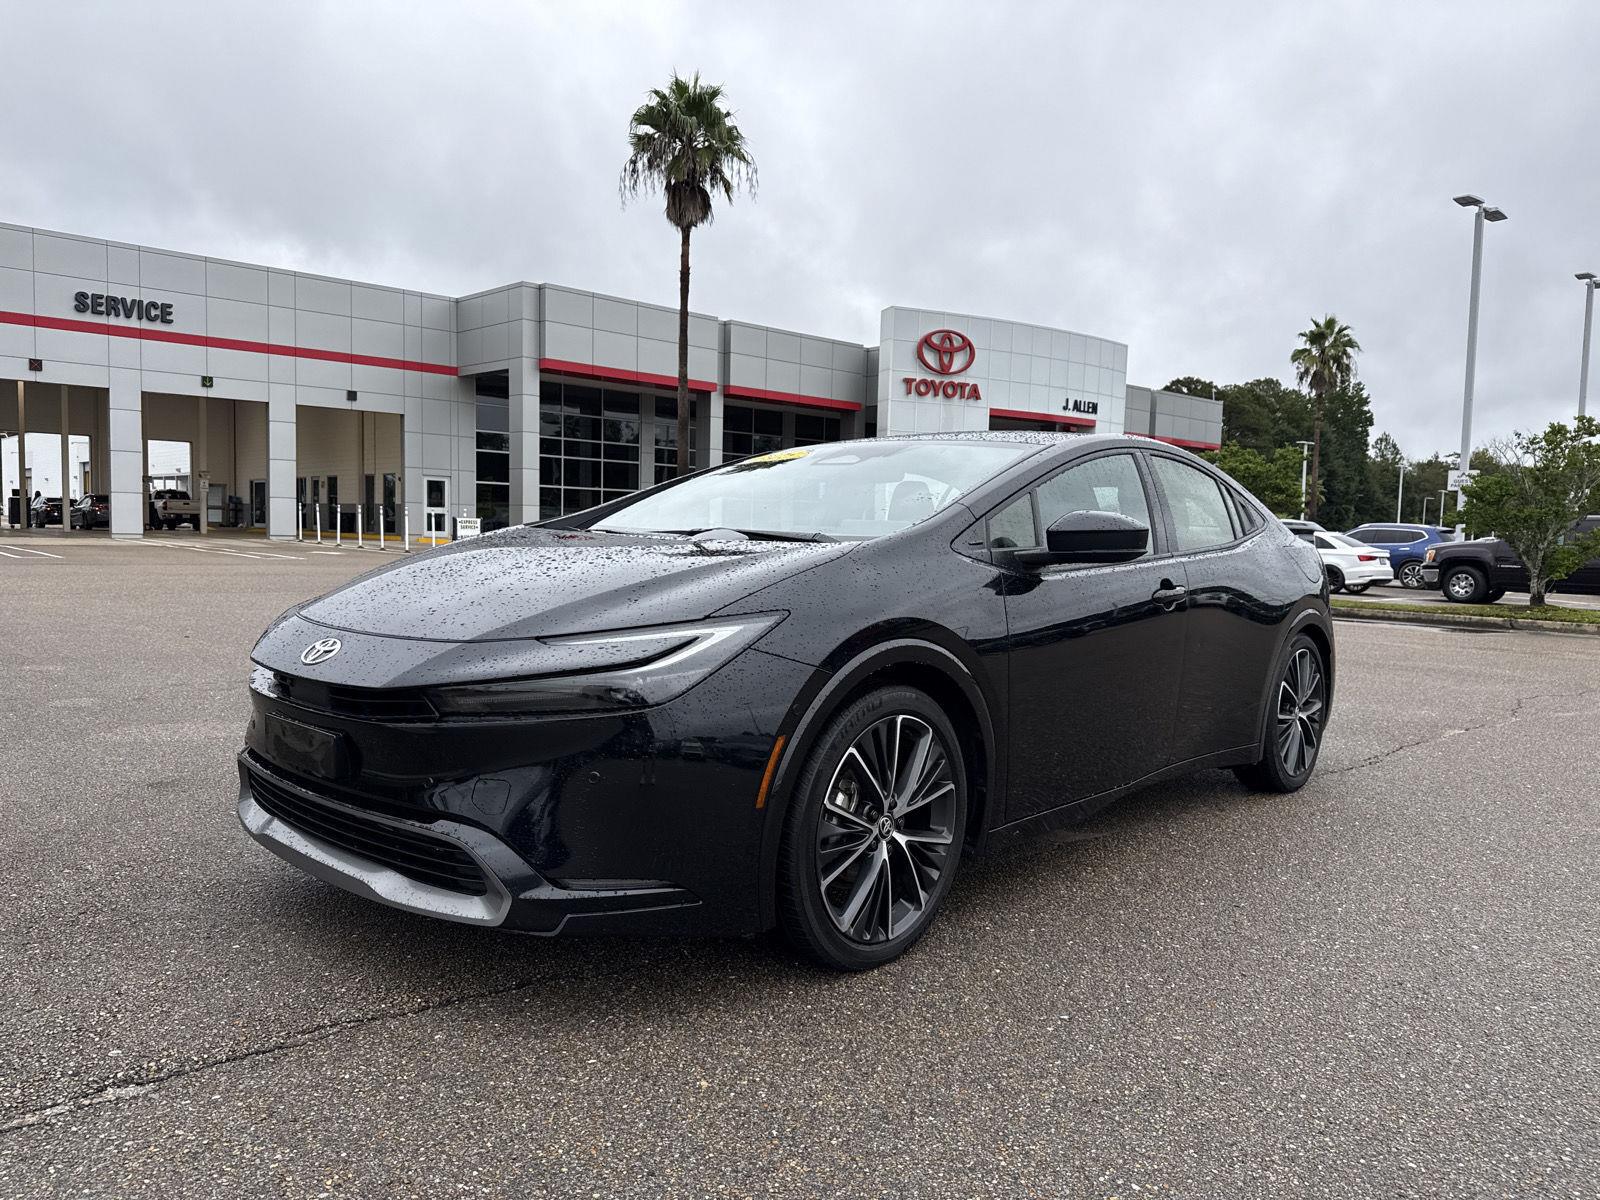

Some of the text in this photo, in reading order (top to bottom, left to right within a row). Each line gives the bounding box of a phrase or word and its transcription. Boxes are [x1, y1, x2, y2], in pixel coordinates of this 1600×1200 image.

[74, 291, 174, 324] SERVICE
[903, 377, 982, 401] TOYOTA
[1062, 398, 1099, 415] J. ALLEN
